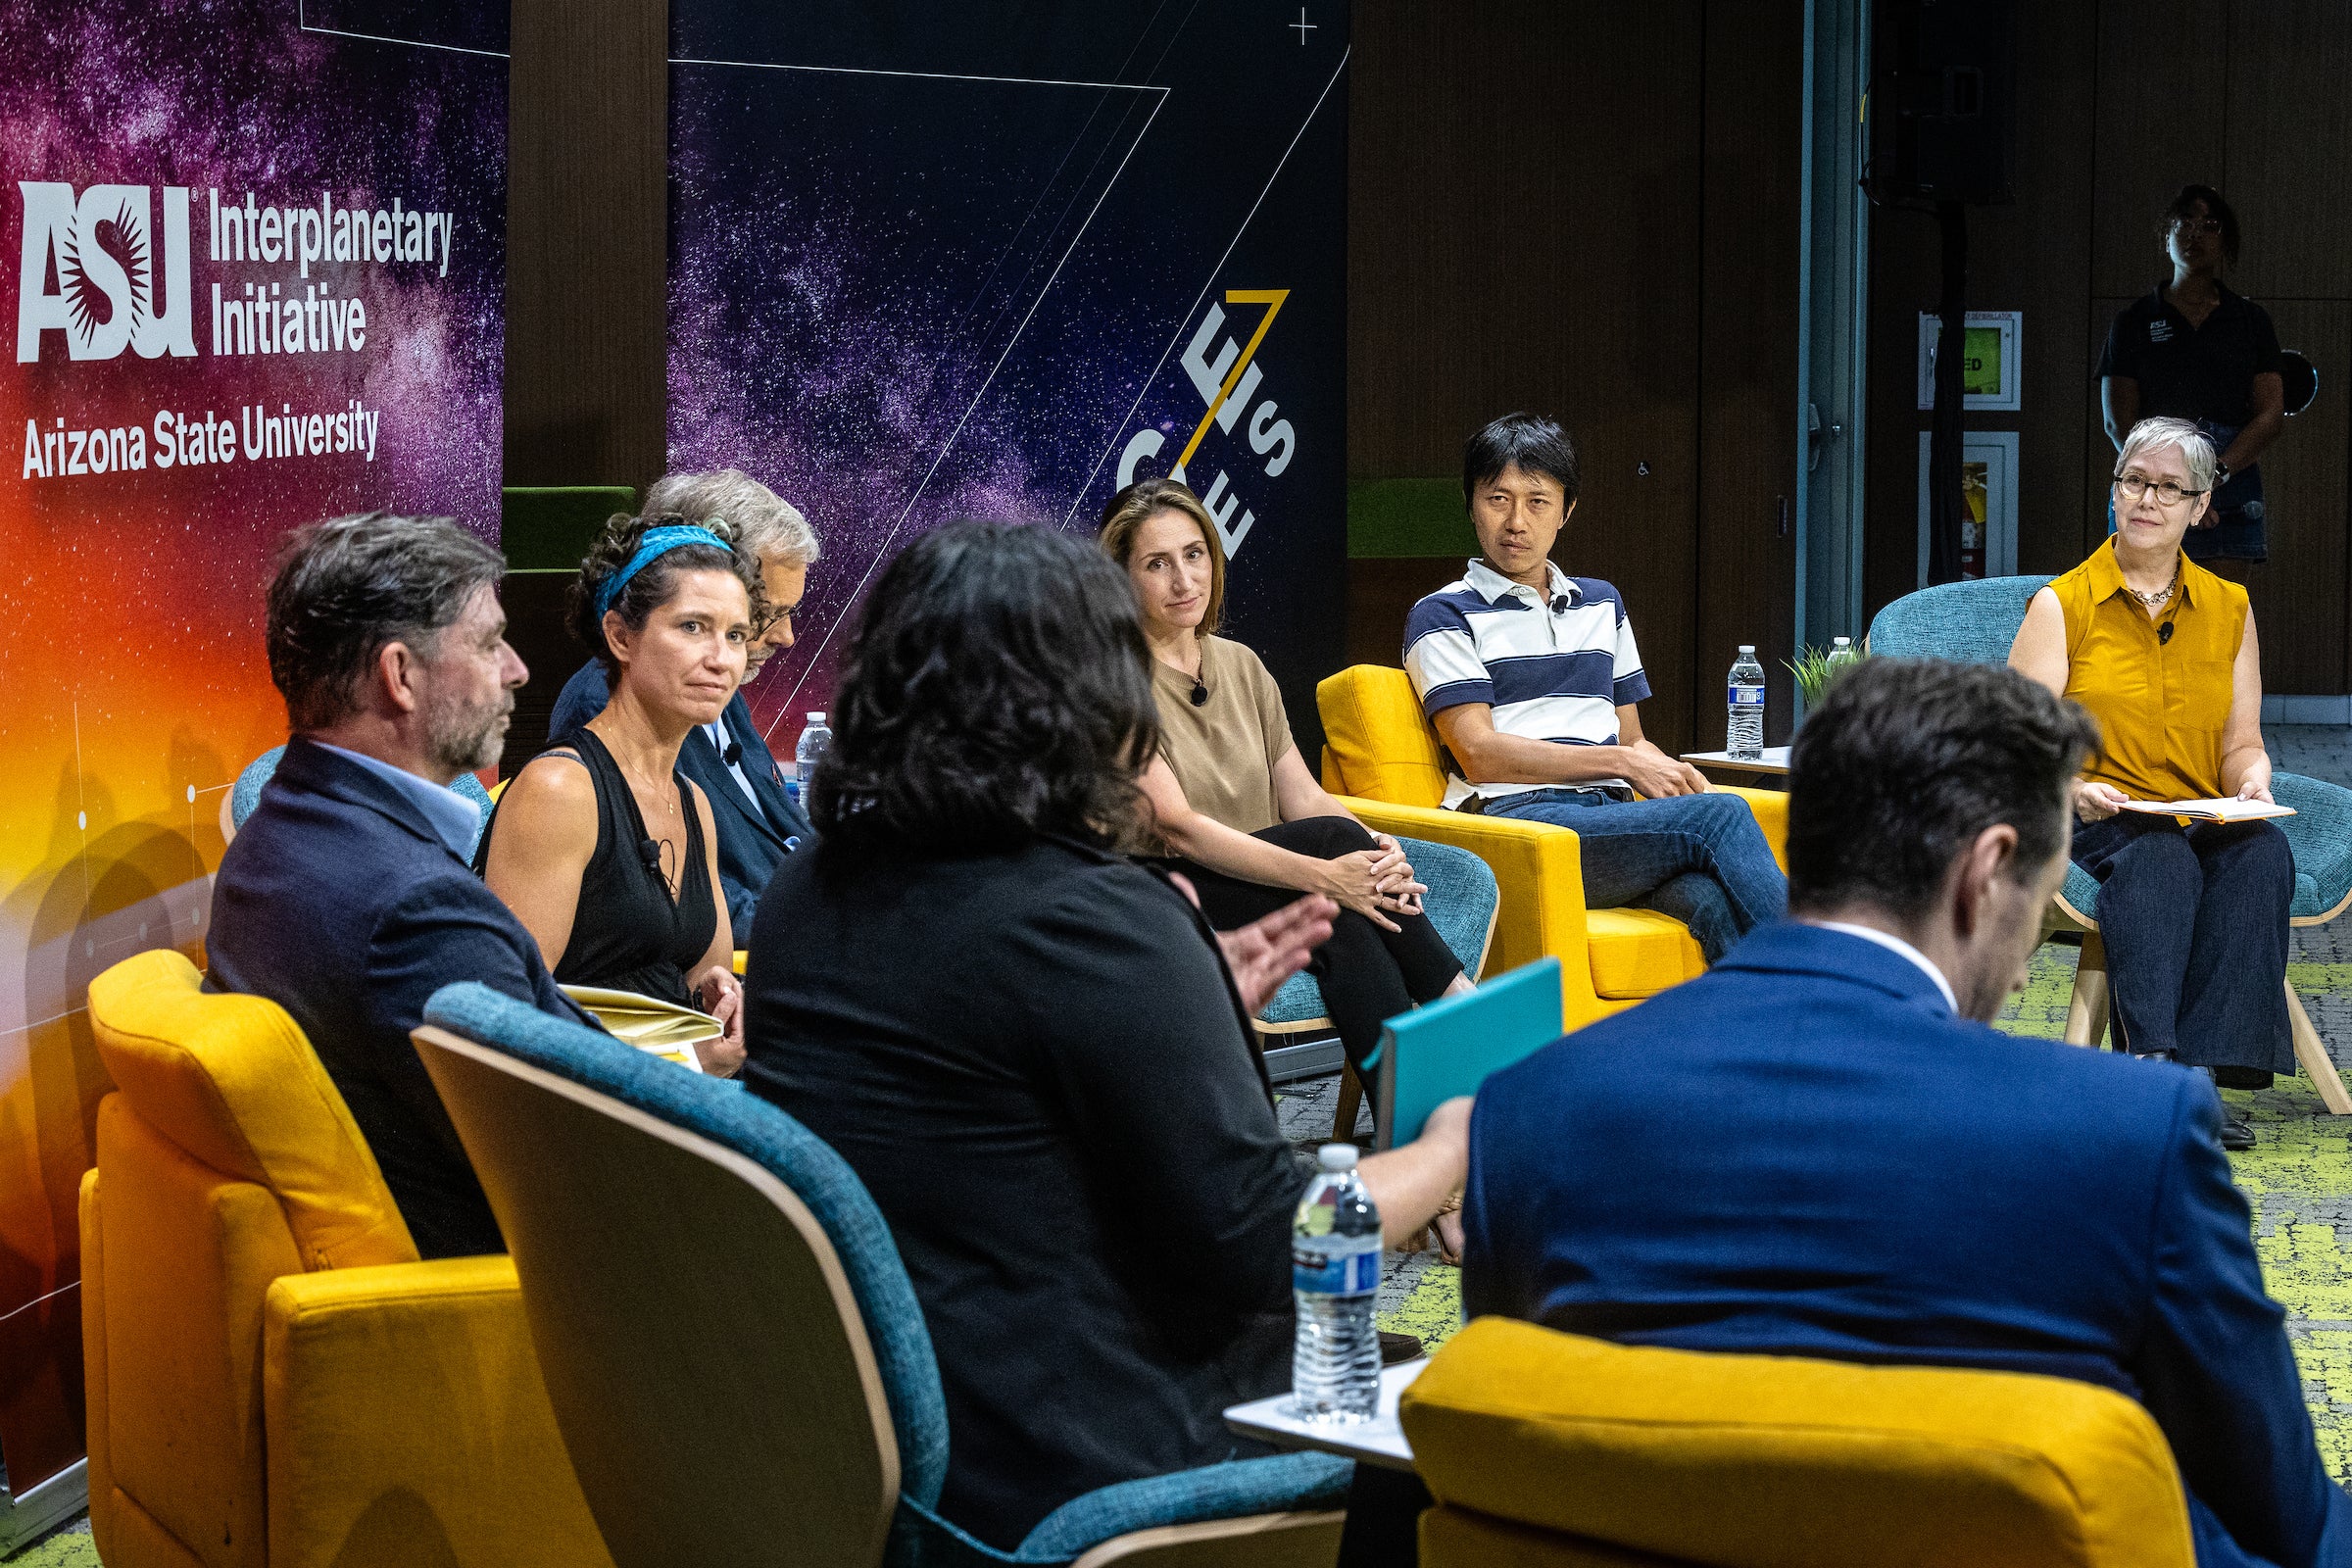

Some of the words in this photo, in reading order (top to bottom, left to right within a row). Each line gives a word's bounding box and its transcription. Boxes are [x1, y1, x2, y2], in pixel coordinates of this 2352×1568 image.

[17, 181, 198, 364] ASU
[209, 187, 453, 279] Interplanetary
[212, 282, 367, 356] Initiative
[23, 417, 147, 479] Arizona
[154, 410, 236, 468] State
[242, 401, 379, 462] University
